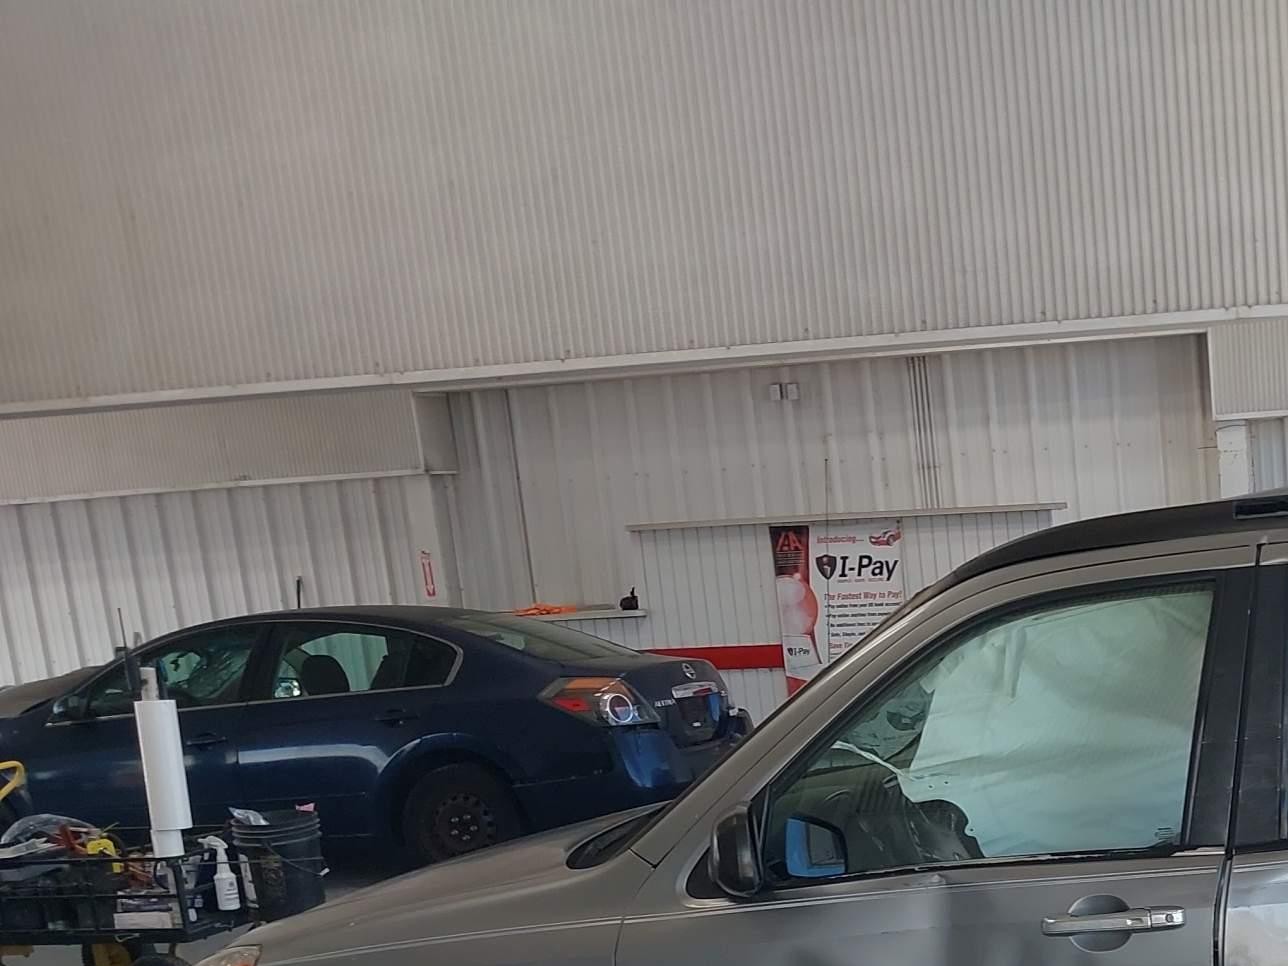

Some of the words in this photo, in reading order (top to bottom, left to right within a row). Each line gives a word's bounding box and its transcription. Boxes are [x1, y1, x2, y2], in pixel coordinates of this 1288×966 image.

[839, 555, 899, 581] I-Pay
[837, 592, 861, 600] Fastest
[863, 592, 877, 600] Way
[794, 647, 810, 656] I-Pay
